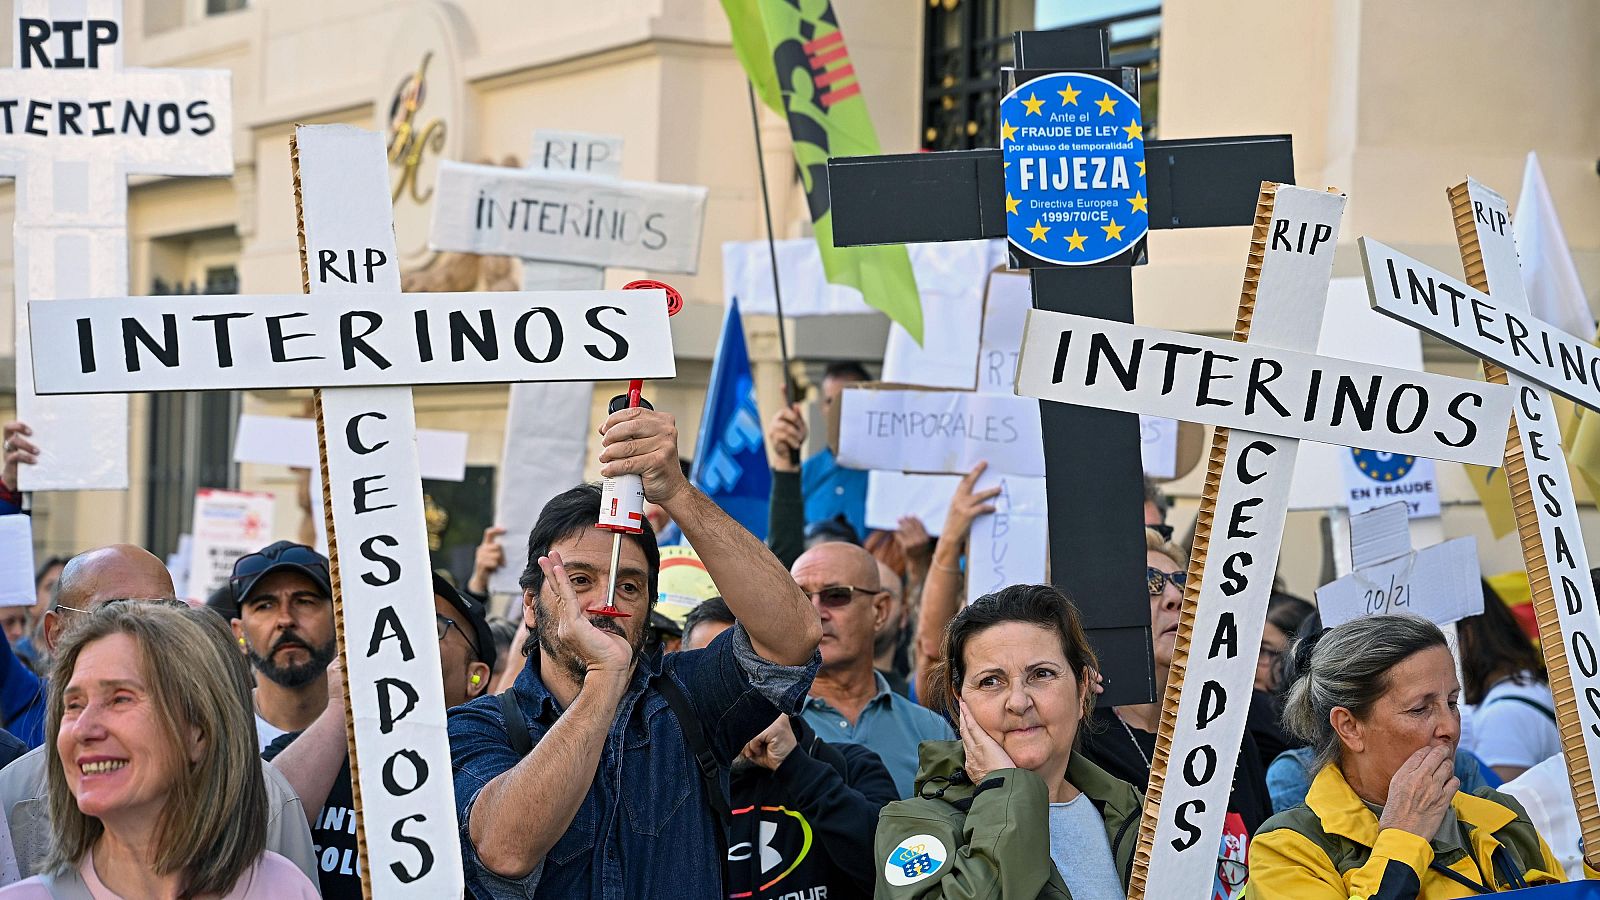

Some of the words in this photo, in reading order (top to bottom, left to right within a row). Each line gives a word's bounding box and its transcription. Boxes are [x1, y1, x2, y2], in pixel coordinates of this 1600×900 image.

[19, 18, 119, 69] RIP
[1021, 126, 1072, 138] FRAUDE
[1075, 126, 1093, 137] DE
[1095, 125, 1119, 137] LEY
[1049, 112, 1076, 123] Ante
[1079, 111, 1090, 123] el
[544, 139, 611, 171] RIP
[1008, 144, 1025, 153] por
[1026, 142, 1056, 152] abuso
[1058, 142, 1070, 151] de
[1071, 141, 1134, 152] temporalidad
[1019, 155, 1130, 191] FIJEZA
[1030, 199, 1074, 209] Directiva
[1076, 198, 1119, 210] Europea
[1041, 210, 1109, 223] 1999/70/CE
[1475, 201, 1507, 236] RIP
[1271, 219, 1332, 255] RIP
[318, 249, 387, 284] RIP
[76, 305, 630, 374] INTERINOS
[1052, 331, 1483, 448] INTERINOS
[866, 410, 1018, 443] TEMPORALES
[1351, 487, 1372, 501] EN
[1375, 480, 1433, 497] FRAUDE
[345, 411, 435, 884] CESADOS
[1170, 440, 1277, 853] CESADOS
